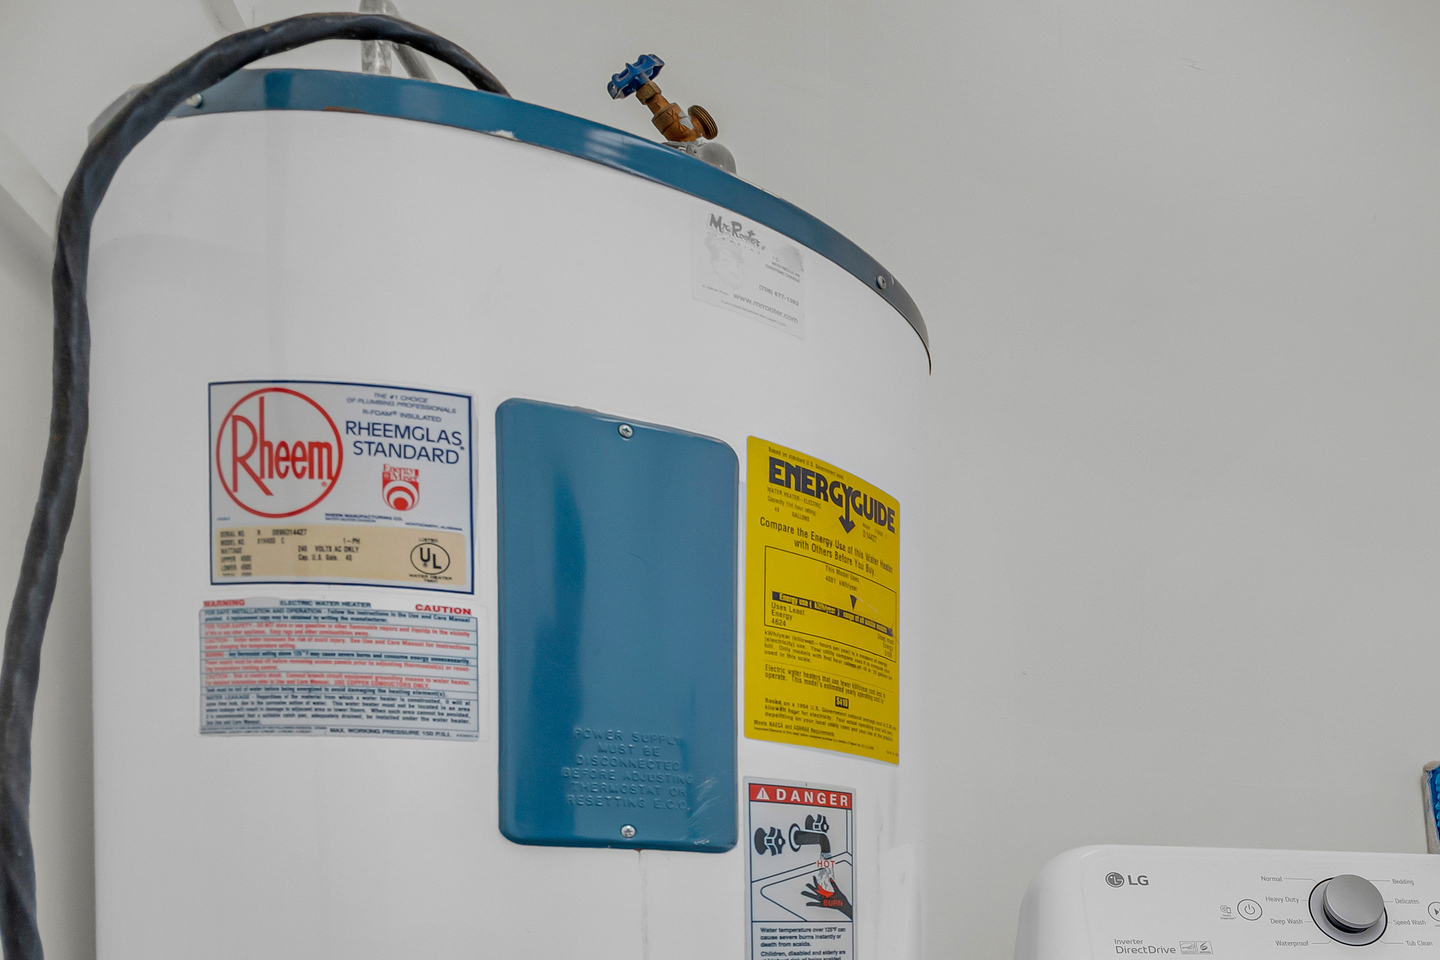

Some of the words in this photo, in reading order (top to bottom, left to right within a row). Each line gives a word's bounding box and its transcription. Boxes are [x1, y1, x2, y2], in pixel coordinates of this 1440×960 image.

[357, 398, 395, 407] PLUMBING
[396, 401, 457, 414] PROFESSIONALS
[400, 395, 428, 403] CHOICE
[400, 412, 442, 422] INSULATED
[231, 396, 333, 496] Rheem
[353, 440, 459, 465] STANDARD
[769, 456, 895, 534] ENERGYGUIDE
[760, 516, 795, 534] Compare
[797, 527, 809, 538] the
[810, 531, 833, 548] Energy
[835, 539, 846, 552] Use
[847, 545, 853, 555] of
[854, 548, 864, 559] this
[865, 551, 879, 566] Water
[794, 539, 809, 551] with
[811, 544, 833, 558] Others
[834, 551, 853, 566] Before
[854, 560, 864, 570] You
[203, 599, 245, 607] WARNING
[415, 603, 472, 616] CAUTION
[771, 602, 786, 612] Uses
[789, 605, 805, 615] Least
[771, 609, 793, 621] Energy
[765, 664, 786, 674] Electric
[573, 727, 623, 741] POWER
[632, 731, 681, 746] SUPPLY
[598, 743, 635, 754] MUST
[643, 745, 661, 757] BE
[576, 755, 681, 771] DISCONNECTED
[561, 766, 616, 780] BEFORE
[623, 770, 694, 785] ADJUSTING
[571, 781, 663, 795] THERMOSTAT
[669, 787, 688, 797] OR
[566, 795, 646, 809] RESETTING
[776, 788, 848, 807] DANGER
[817, 860, 835, 868] HOT
[1127, 874, 1149, 886] LG
[1391, 878, 1415, 886] Bedding
[823, 899, 843, 907] BURN
[1285, 896, 1300, 904] Duty
